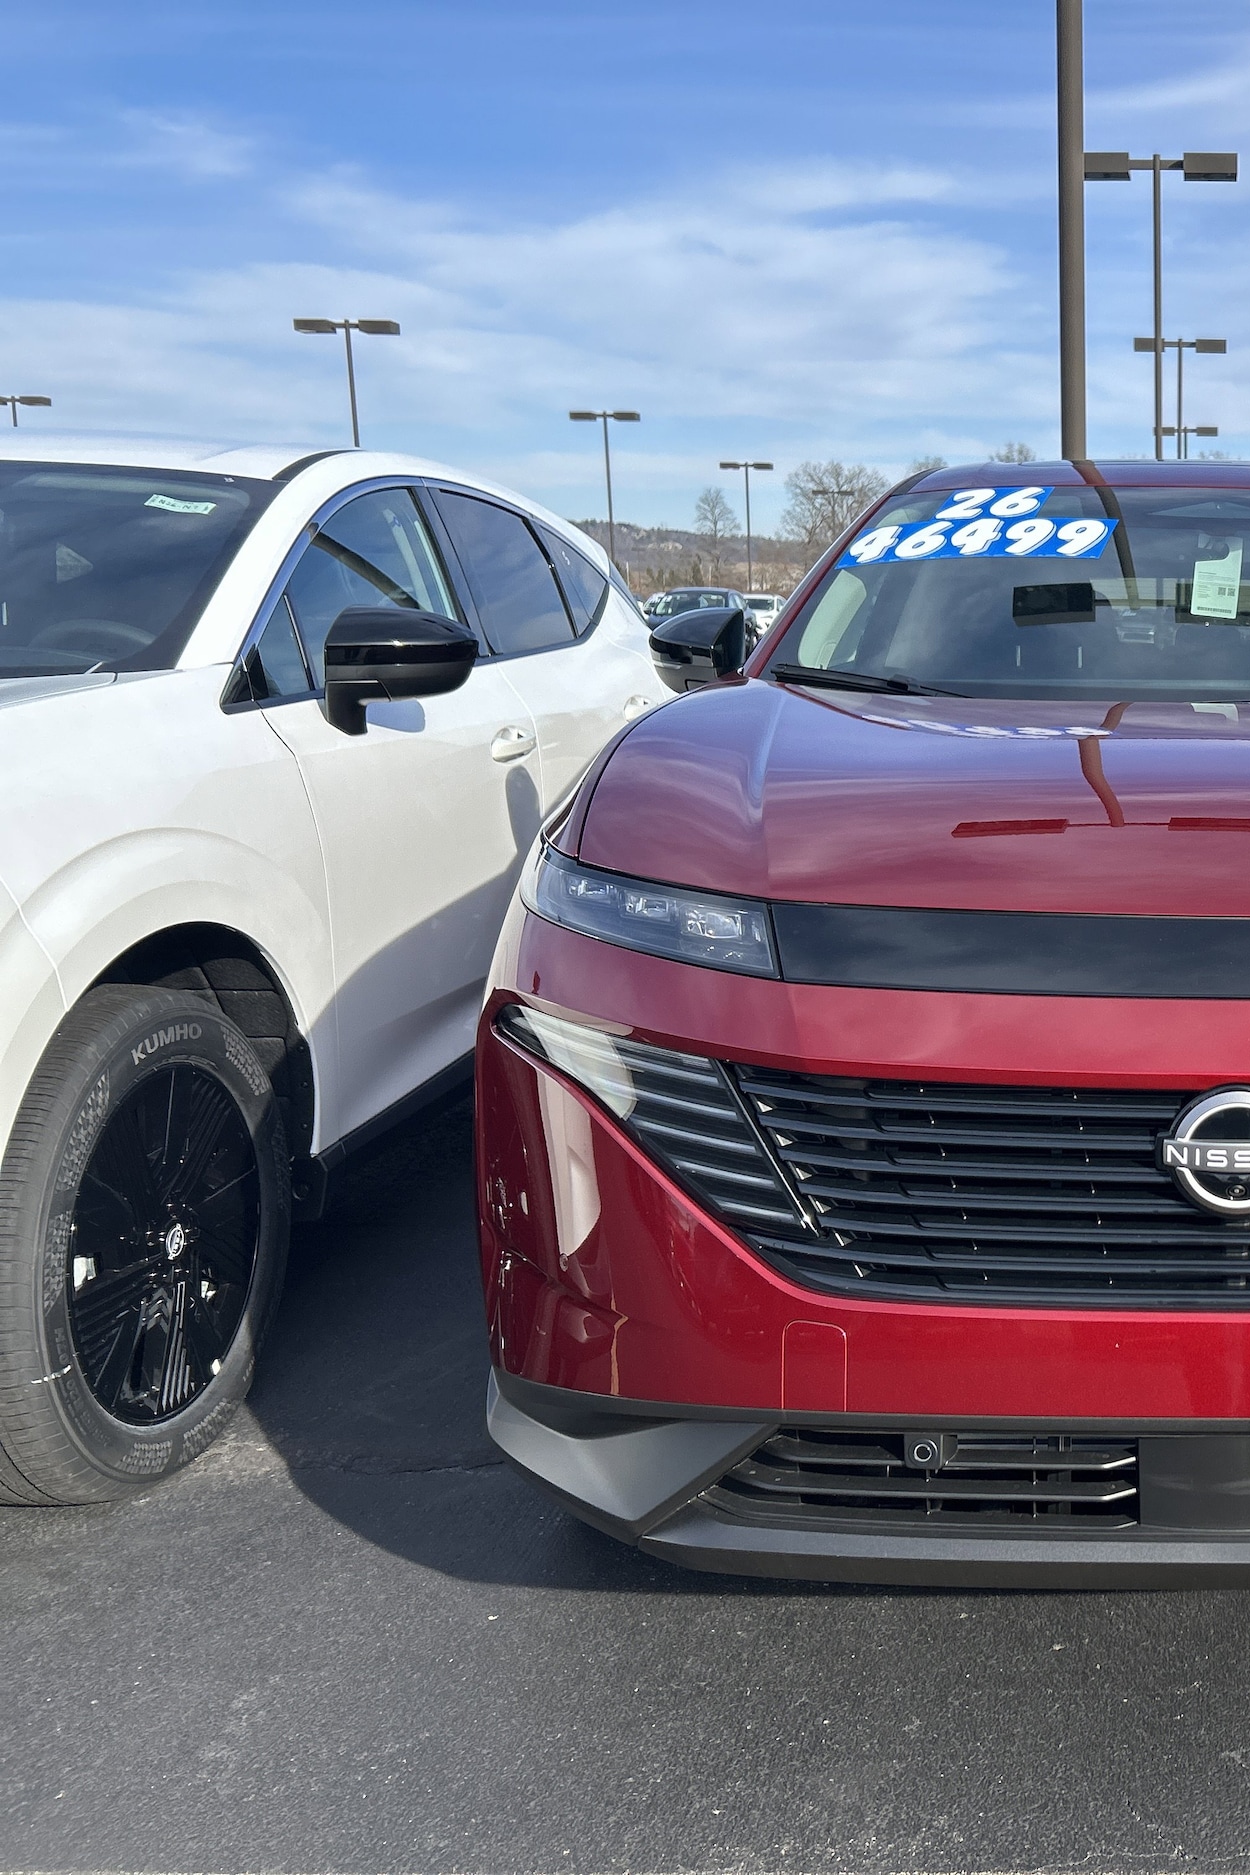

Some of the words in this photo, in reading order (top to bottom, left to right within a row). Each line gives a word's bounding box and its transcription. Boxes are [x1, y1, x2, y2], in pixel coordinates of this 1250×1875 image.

[935, 487, 1045, 520] 26
[849, 518, 1109, 563] 46499
[130, 1022, 202, 1066] KUMHO
